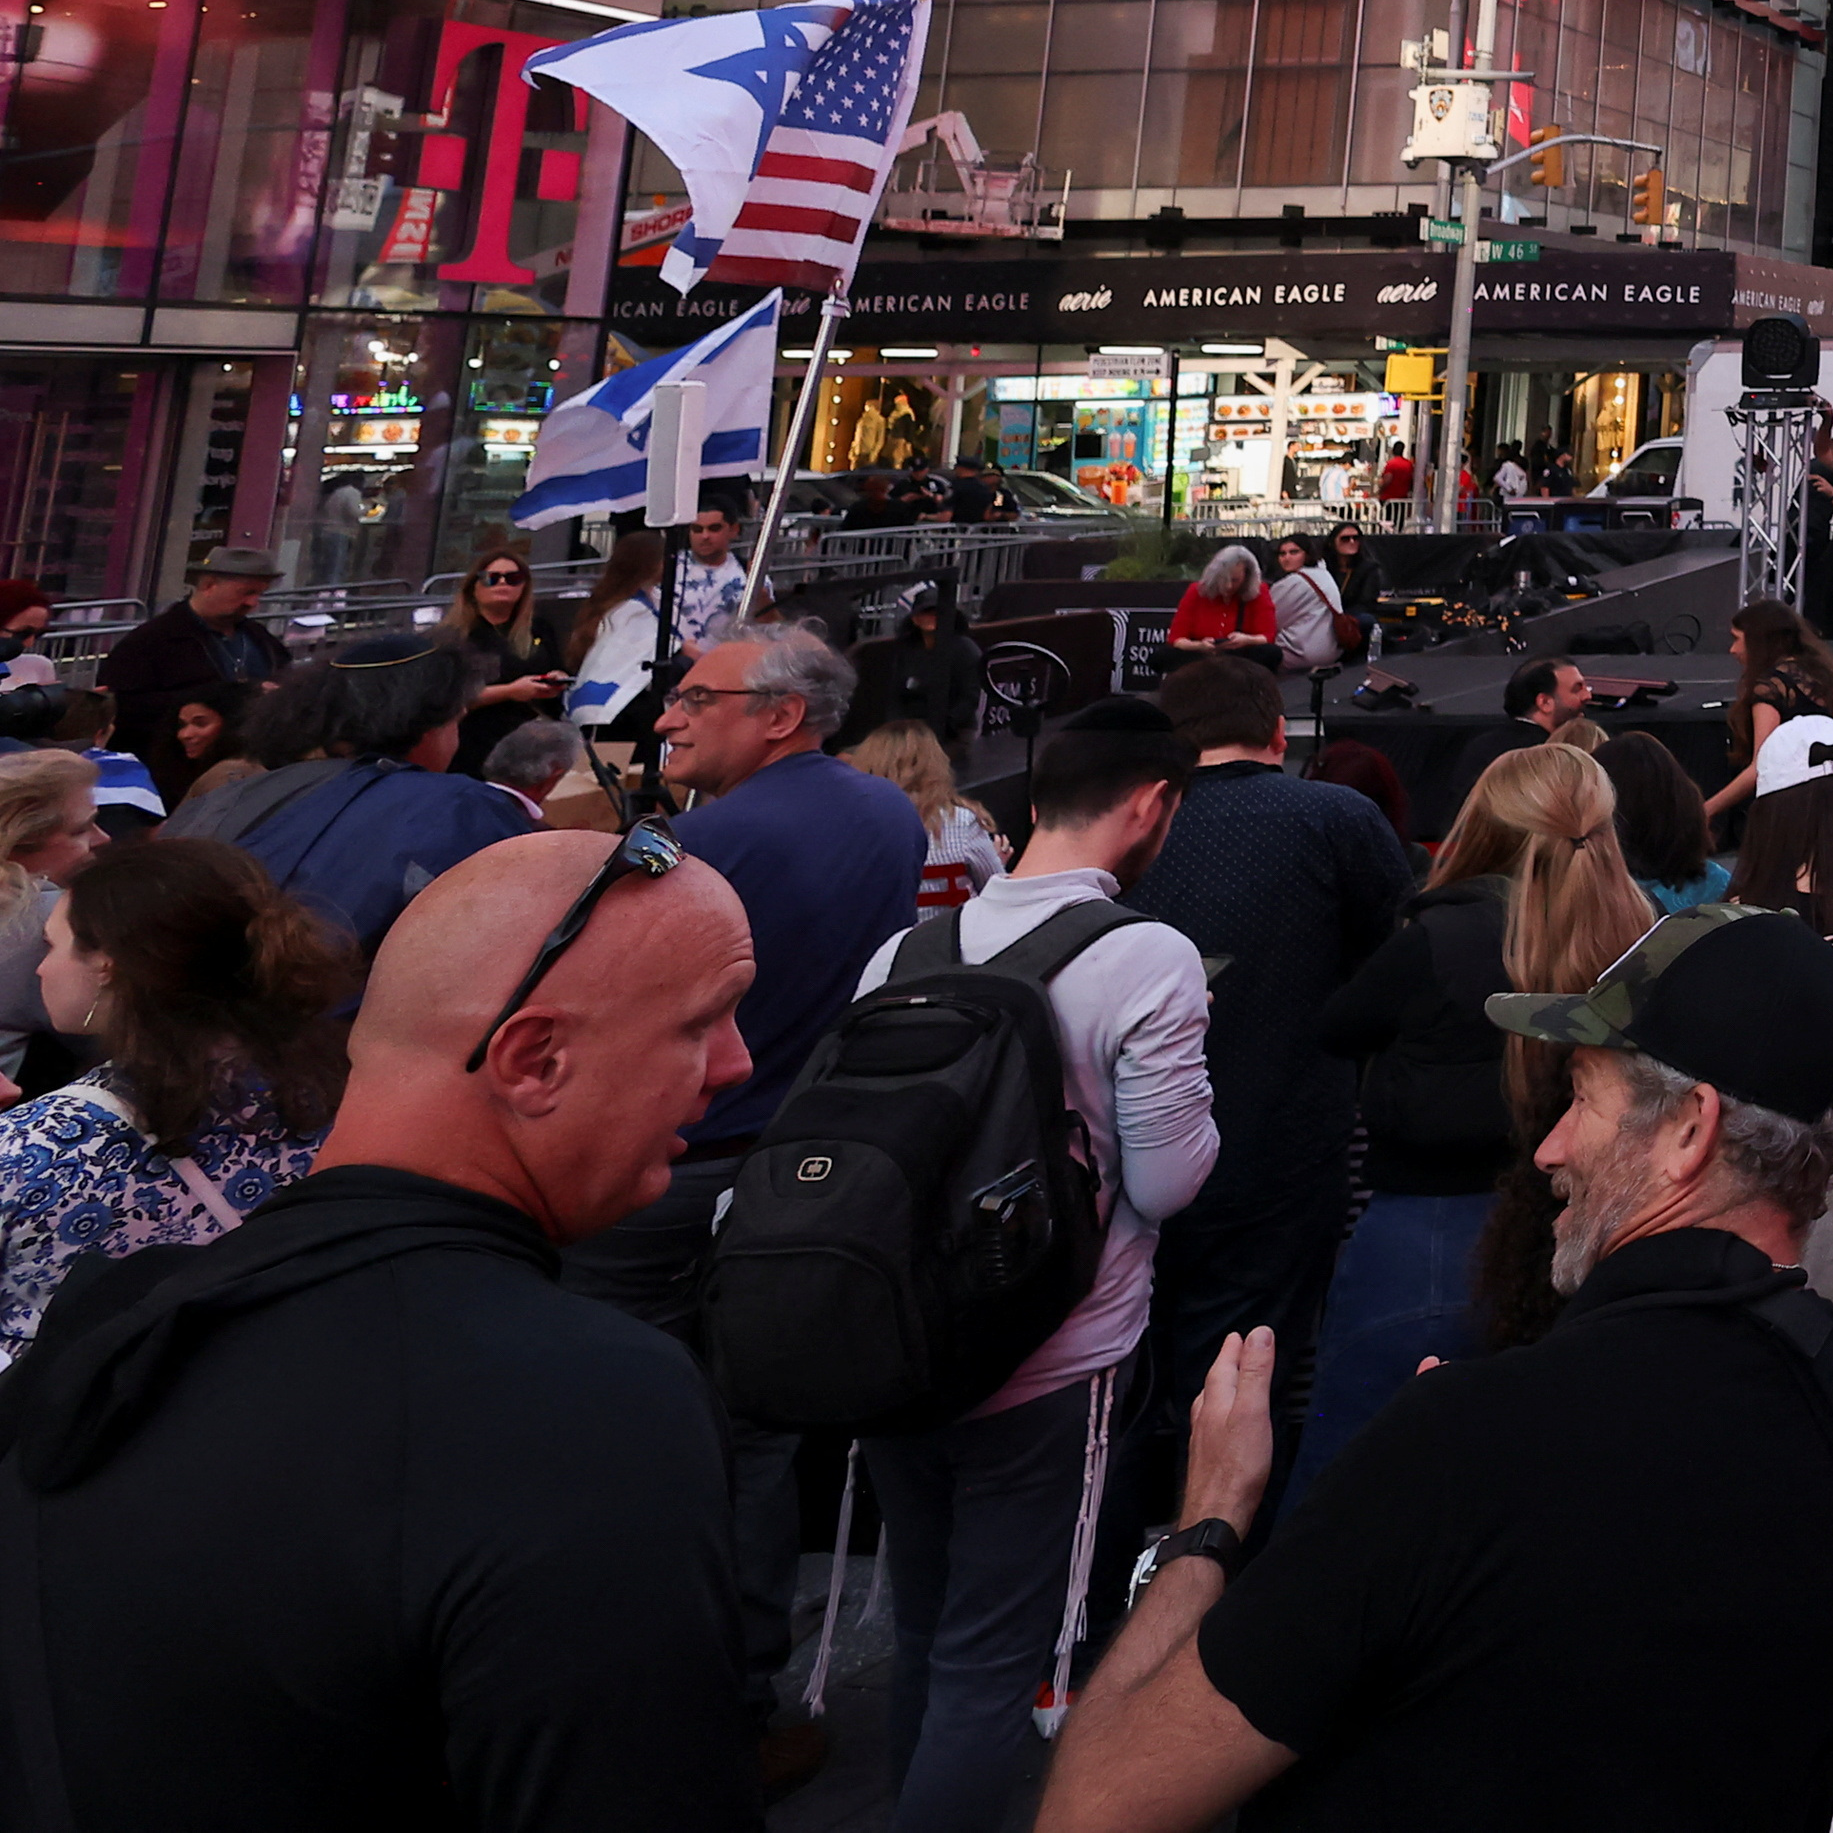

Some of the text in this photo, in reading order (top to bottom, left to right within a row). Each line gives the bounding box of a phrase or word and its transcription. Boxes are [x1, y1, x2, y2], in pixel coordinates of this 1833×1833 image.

[1430, 221, 1464, 245] Broadway
[1492, 244, 1503, 259] W
[1508, 244, 1524, 260] 46
[1058, 283, 1114, 314] aerie
[1143, 282, 1347, 308] AMERICAN EAGLE
[1376, 275, 1439, 305] aerie
[1473, 282, 1701, 304] AMERICAN EAGLE
[1731, 288, 1802, 314] AMERICAN EAGLE
[613, 298, 740, 318] ICAN EAGLE
[964, 292, 1030, 312] EAGLE
[997, 676, 1037, 697] TIMS
